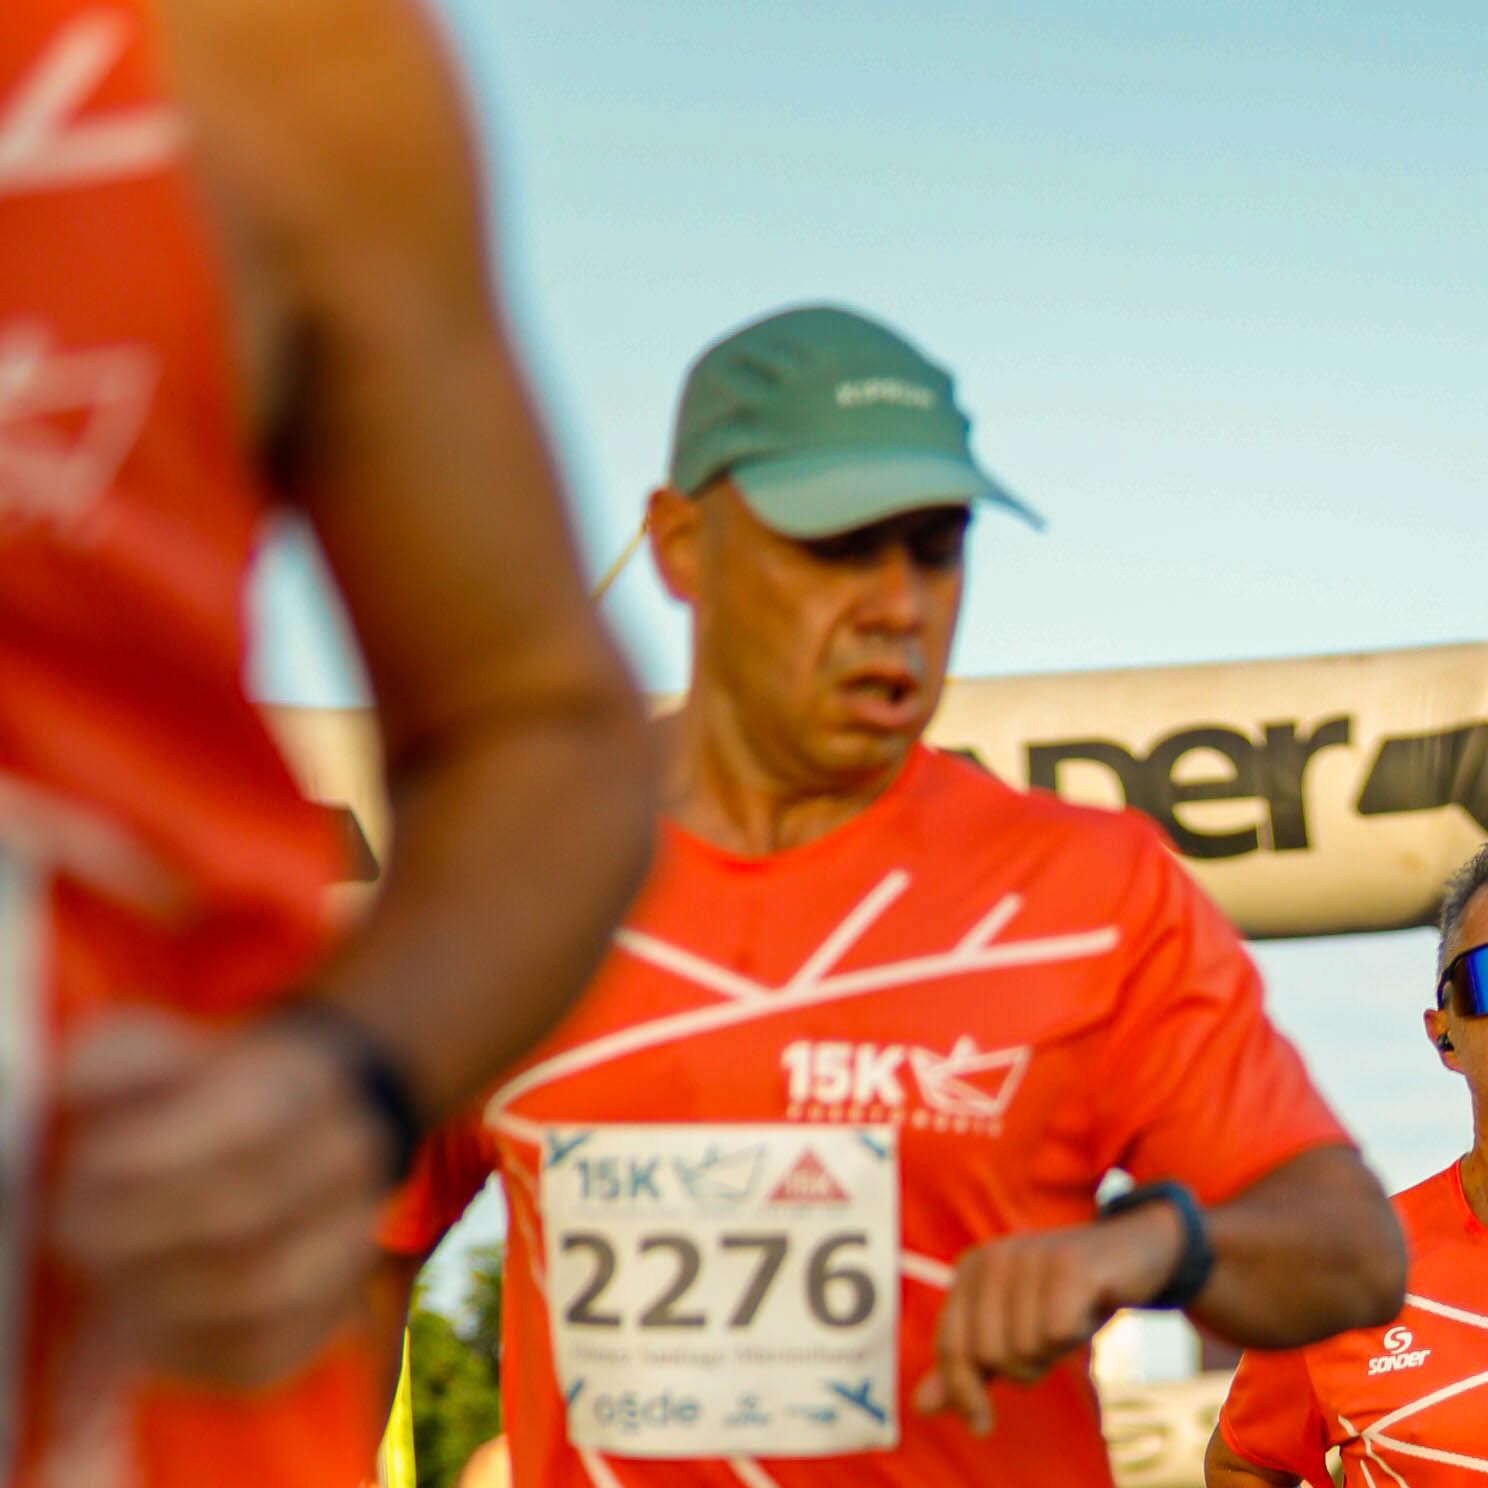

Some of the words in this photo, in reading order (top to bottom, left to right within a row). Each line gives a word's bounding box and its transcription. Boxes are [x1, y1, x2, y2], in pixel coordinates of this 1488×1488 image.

[781, 1041, 905, 1105] 15K
[578, 1156, 662, 1200] 15K
[560, 1233, 876, 1328] 2276
